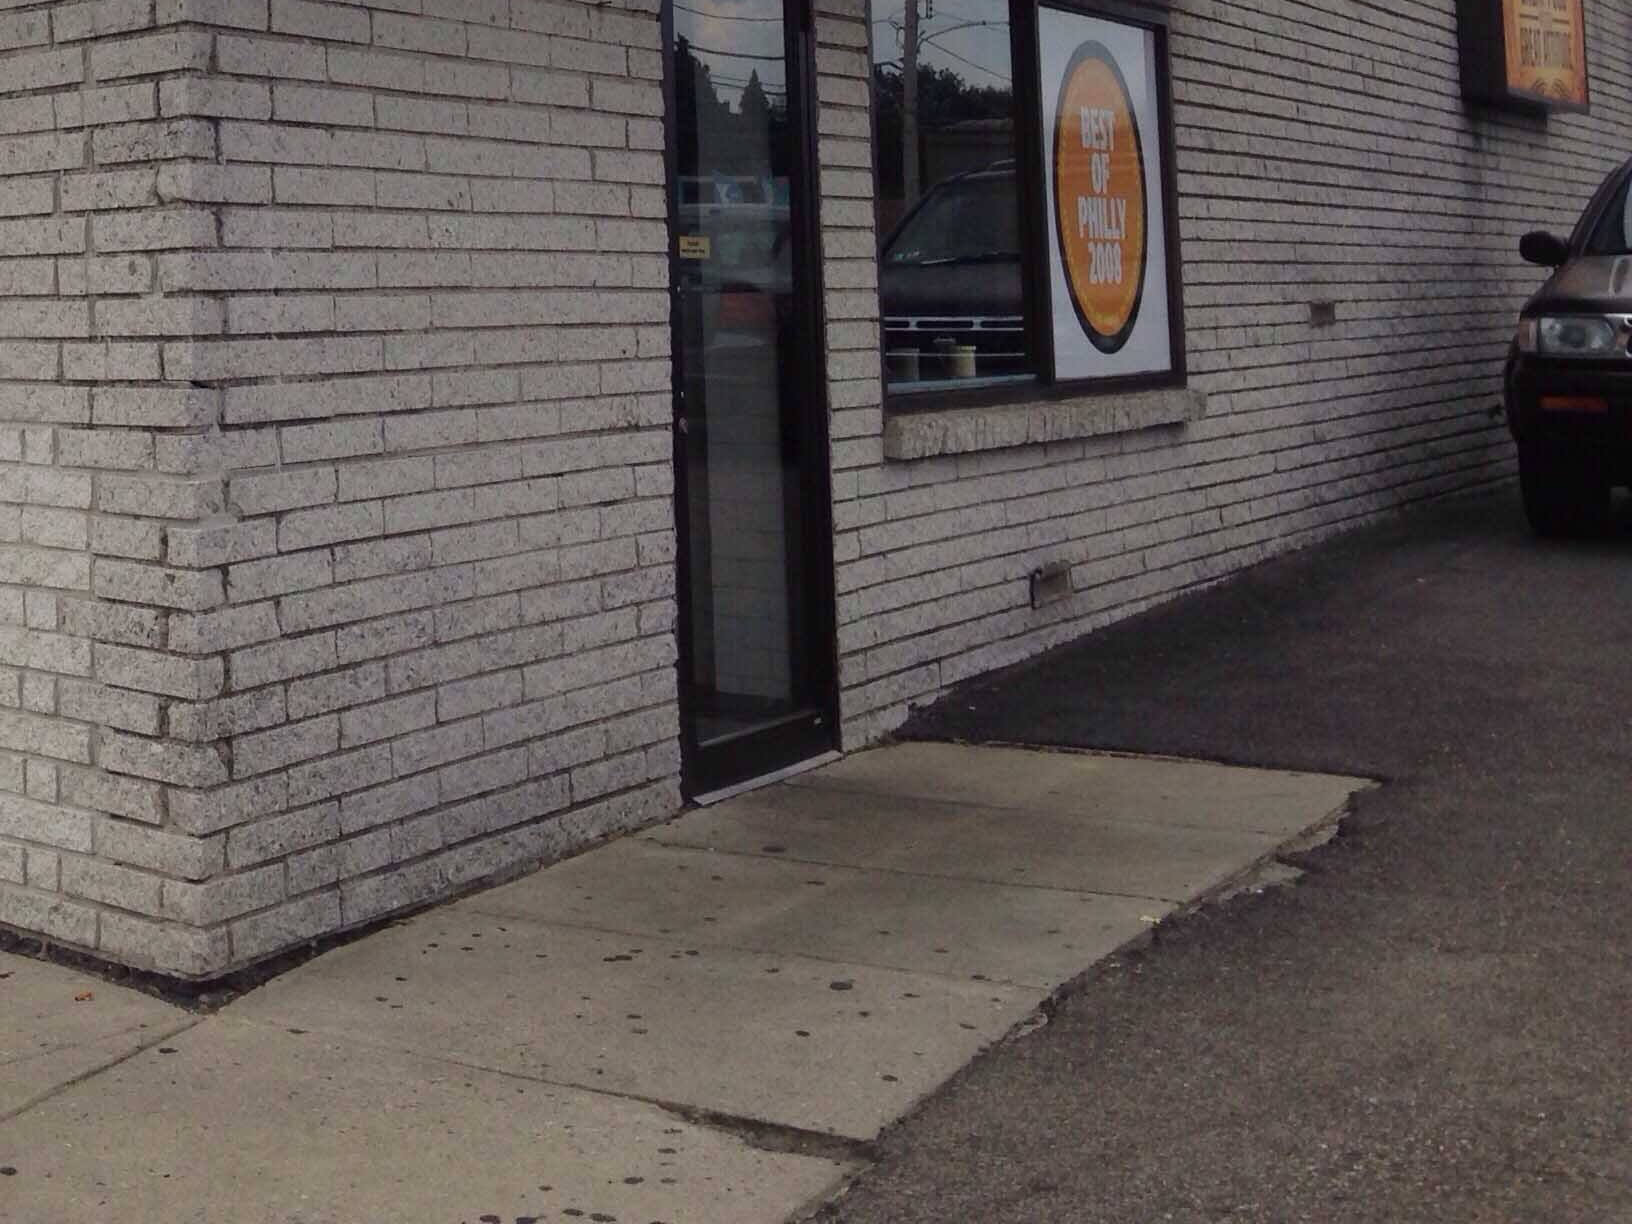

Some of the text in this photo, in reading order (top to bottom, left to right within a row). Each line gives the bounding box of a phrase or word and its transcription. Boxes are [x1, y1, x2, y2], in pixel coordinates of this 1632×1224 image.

[1080, 106, 1116, 152] BEST
[1090, 153, 1111, 195] OF
[1077, 195, 1127, 241] PHILLY
[1087, 242, 1123, 286] 2008
